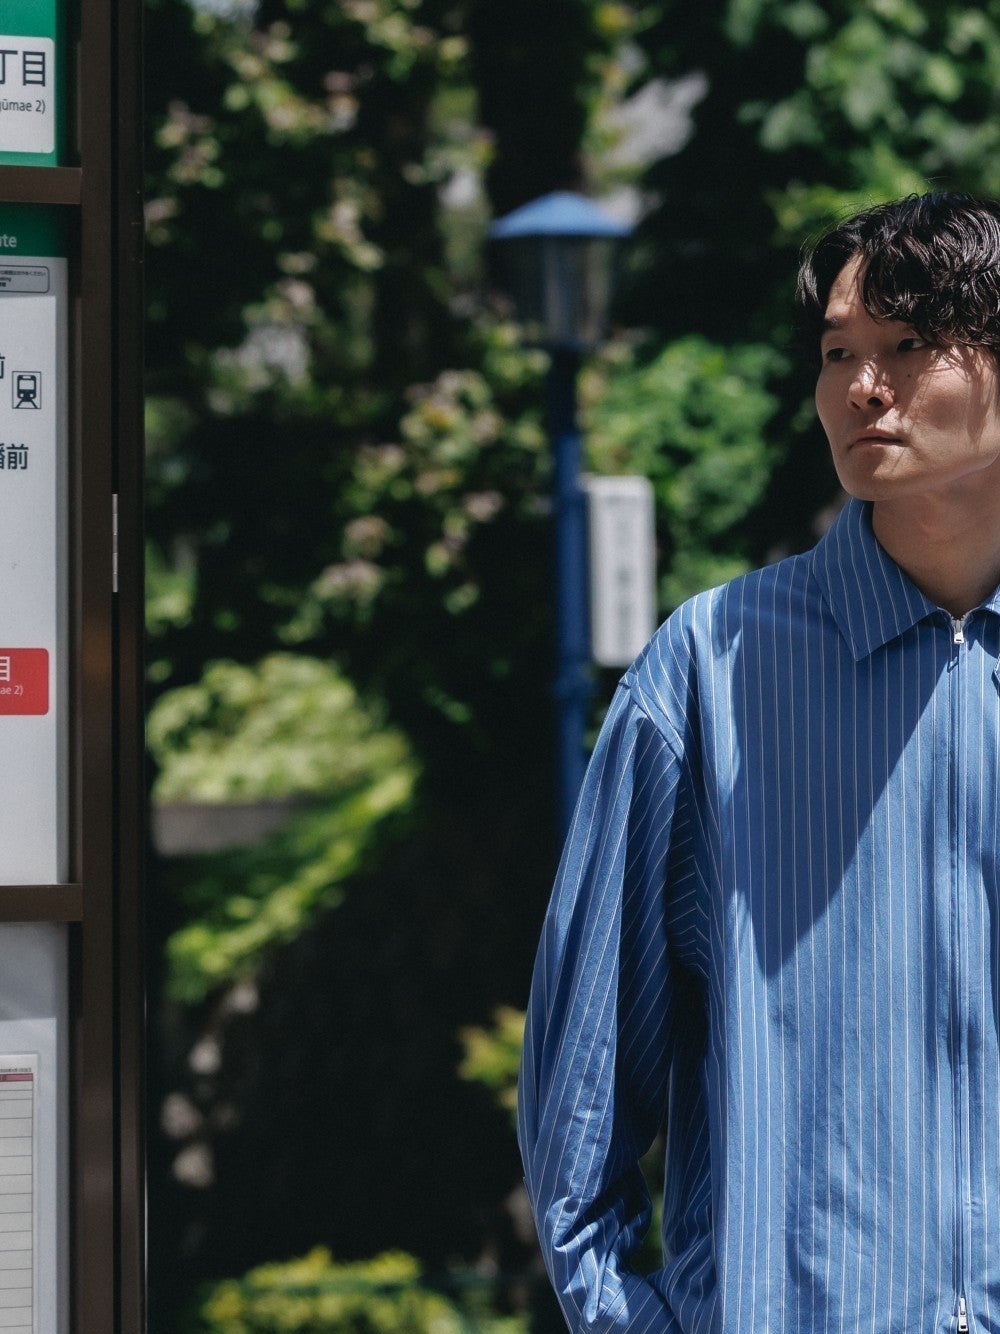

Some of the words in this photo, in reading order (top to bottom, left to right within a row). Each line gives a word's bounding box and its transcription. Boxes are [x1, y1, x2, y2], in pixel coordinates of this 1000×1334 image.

[0, 98, 32, 113] ūmae
[35, 99, 46, 115] 2)
[0, 233, 17, 248] te
[0, 443, 29, 470] 前
[13, 684, 24, 697] 2)
